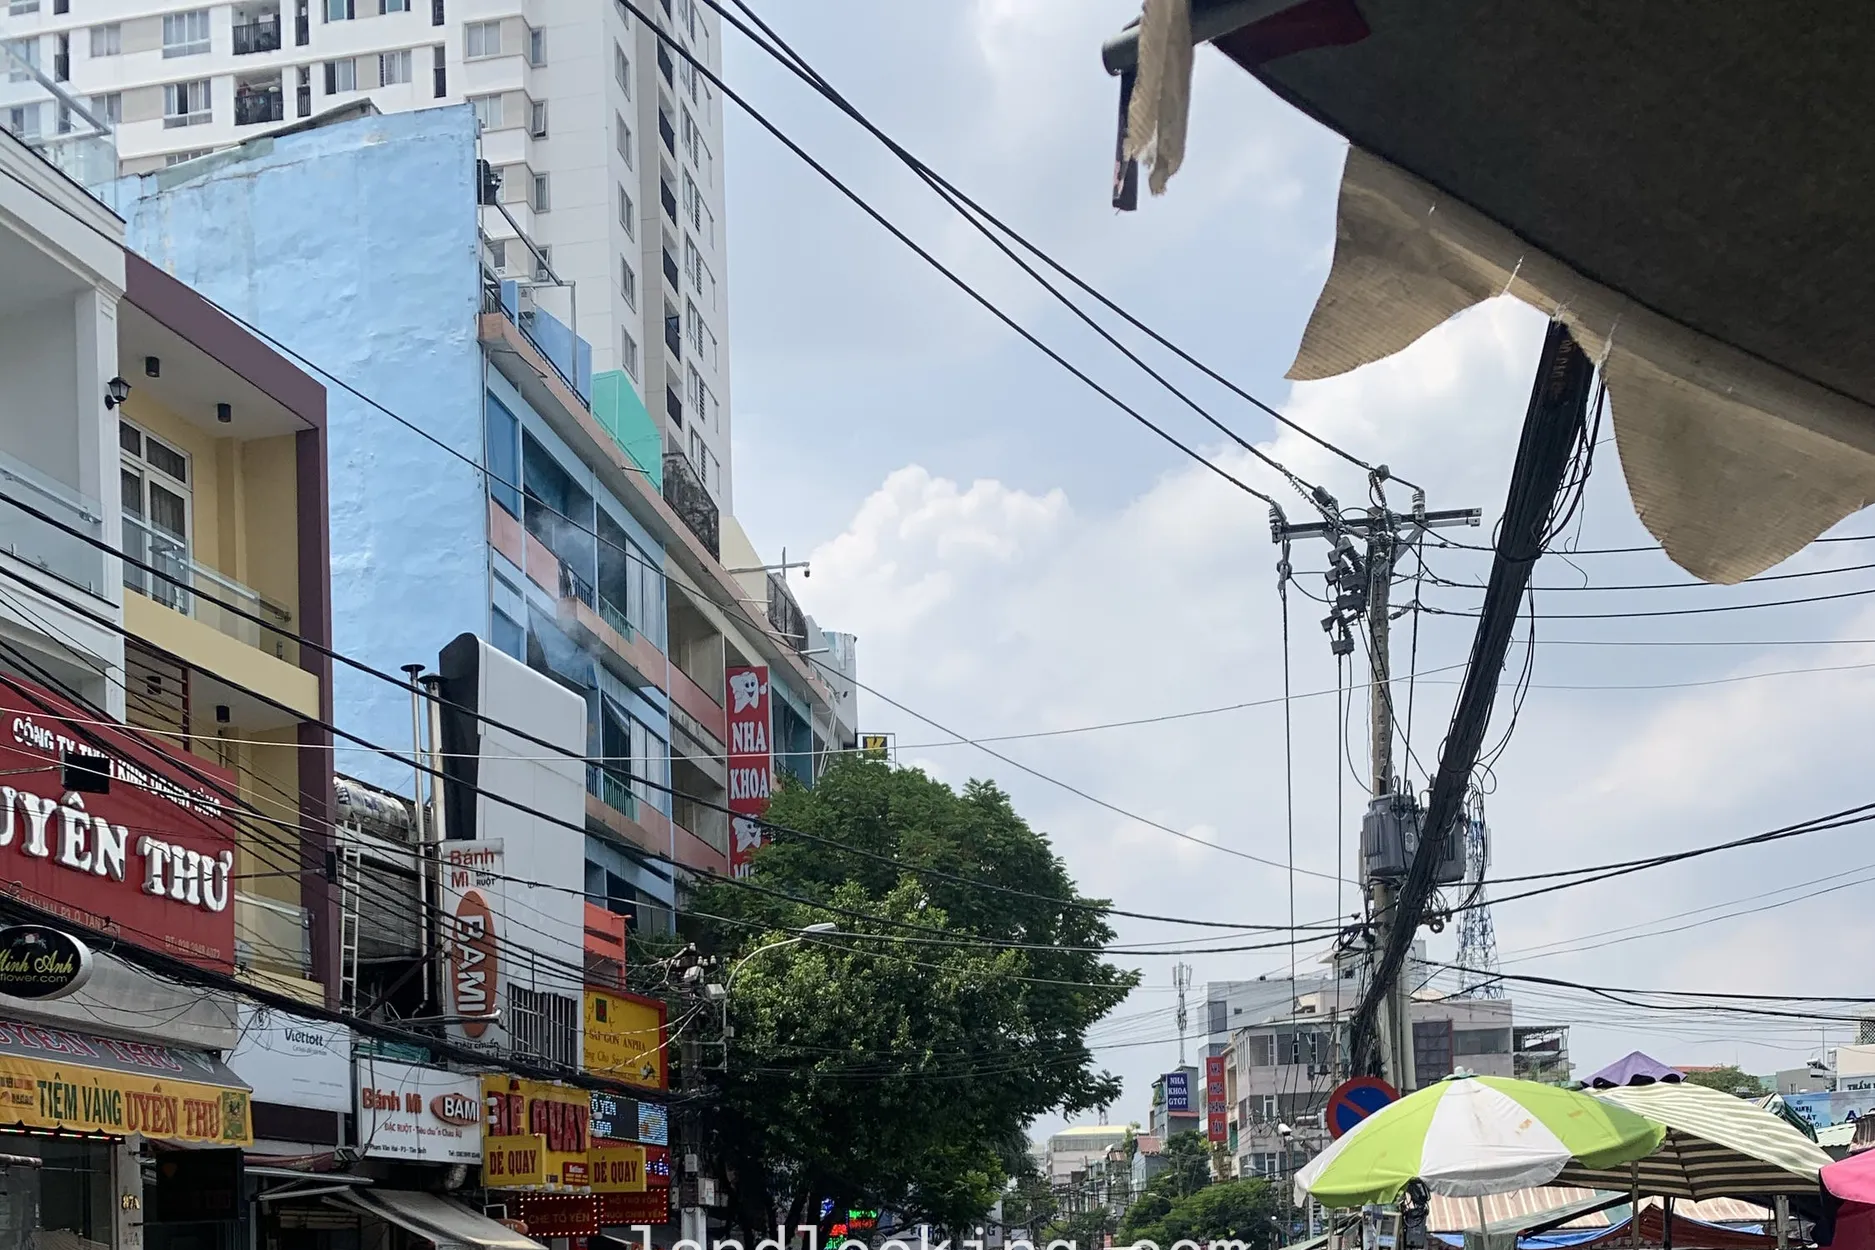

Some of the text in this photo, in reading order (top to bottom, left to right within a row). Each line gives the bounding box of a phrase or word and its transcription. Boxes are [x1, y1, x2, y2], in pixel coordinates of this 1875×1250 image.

[13, 716, 55, 751] CÔNG
[732, 721, 767, 753] NHA
[730, 768, 769, 800] KHOA
[450, 847, 494, 867] Bánh
[137, 835, 233, 912] THƯ
[458, 915, 487, 1012] BAMI
[1168, 1087, 1187, 1095] KHOA
[1170, 1077, 1185, 1085] NHA
[82, 1077, 121, 1126] VÀNG
[125, 1083, 178, 1134] UYÊN
[183, 1095, 221, 1138] THƯ
[362, 1087, 400, 1112] Bánh
[444, 1097, 480, 1122] BAMI
[508, 1150, 537, 1177] QUAY
[611, 1161, 638, 1185] QUAY
